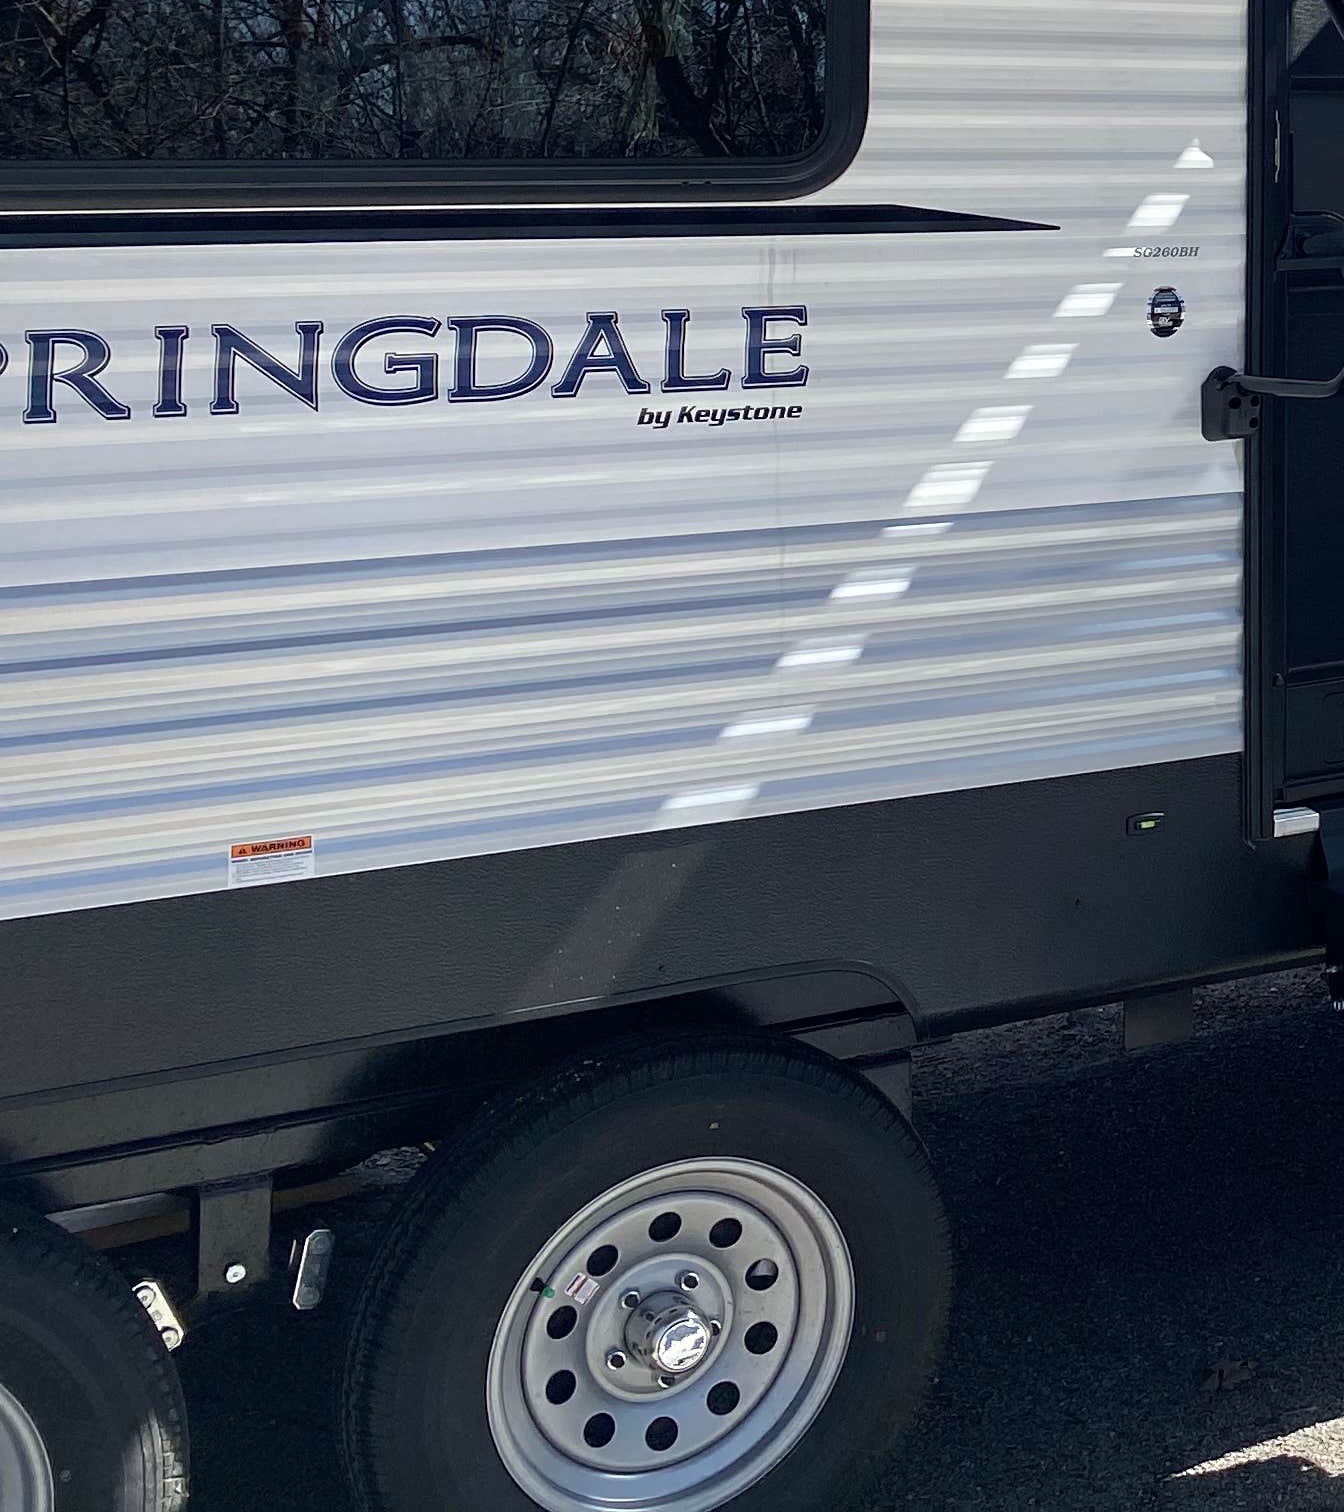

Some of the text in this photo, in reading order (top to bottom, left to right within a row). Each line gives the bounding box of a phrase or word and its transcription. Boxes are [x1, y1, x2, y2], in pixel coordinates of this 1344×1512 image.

[1133, 246, 1200, 258] SG260BH
[0, 305, 809, 424] RINGDALE
[637, 405, 803, 429] by Keystone
[250, 838, 306, 853] WARNING
